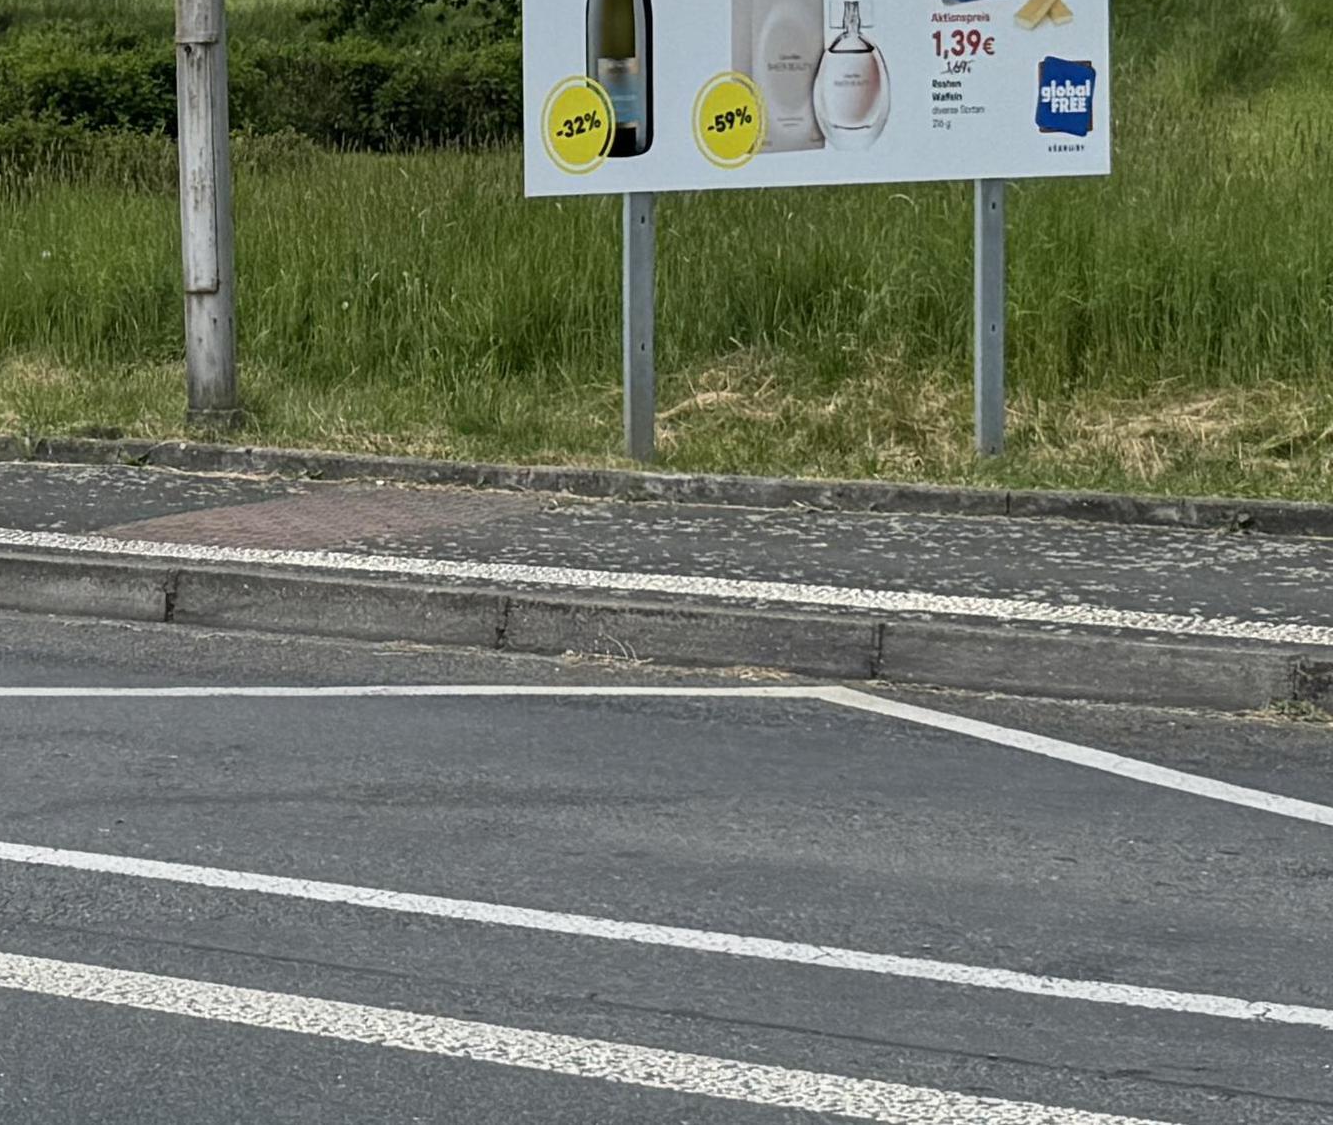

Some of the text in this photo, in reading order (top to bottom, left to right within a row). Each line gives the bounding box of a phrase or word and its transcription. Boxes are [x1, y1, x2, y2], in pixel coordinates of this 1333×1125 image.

[931, 12, 990, 24] Aktionspreis
[932, 29, 995, 59] 1,39€
[1041, 79, 1091, 103] global
[1051, 96, 1088, 113] FREE
[556, 110, 602, 138] -32%
[707, 105, 753, 133] -59%
